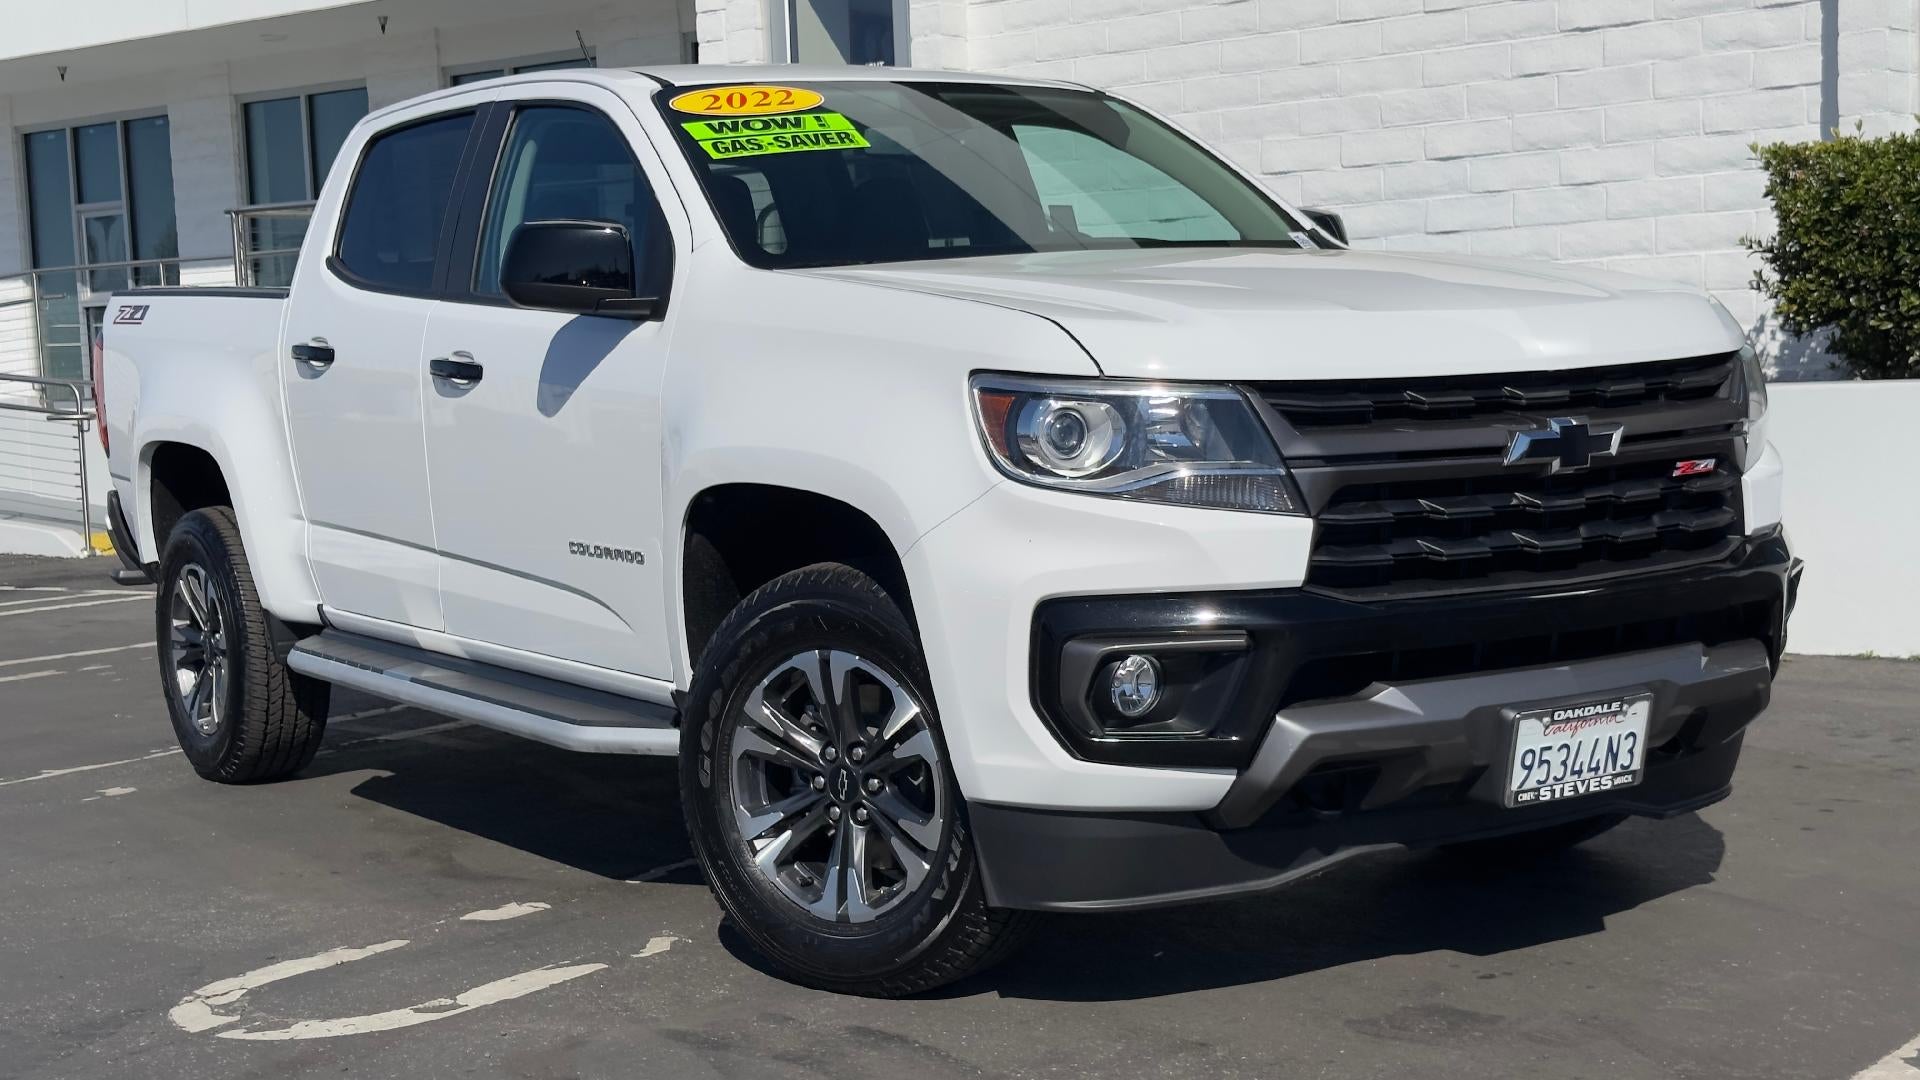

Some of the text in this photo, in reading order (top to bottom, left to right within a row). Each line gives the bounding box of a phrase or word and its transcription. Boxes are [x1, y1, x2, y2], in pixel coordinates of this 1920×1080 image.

[702, 89, 796, 111] 2022
[703, 116, 805, 136] WOW
[711, 131, 855, 154] GAS-SAVER
[113, 304, 150, 325] Z71
[568, 541, 646, 566] COLORADO
[1553, 701, 1622, 721] OAKDALE
[1517, 731, 1638, 790] 95344N3
[1539, 775, 1613, 801] STEVES
